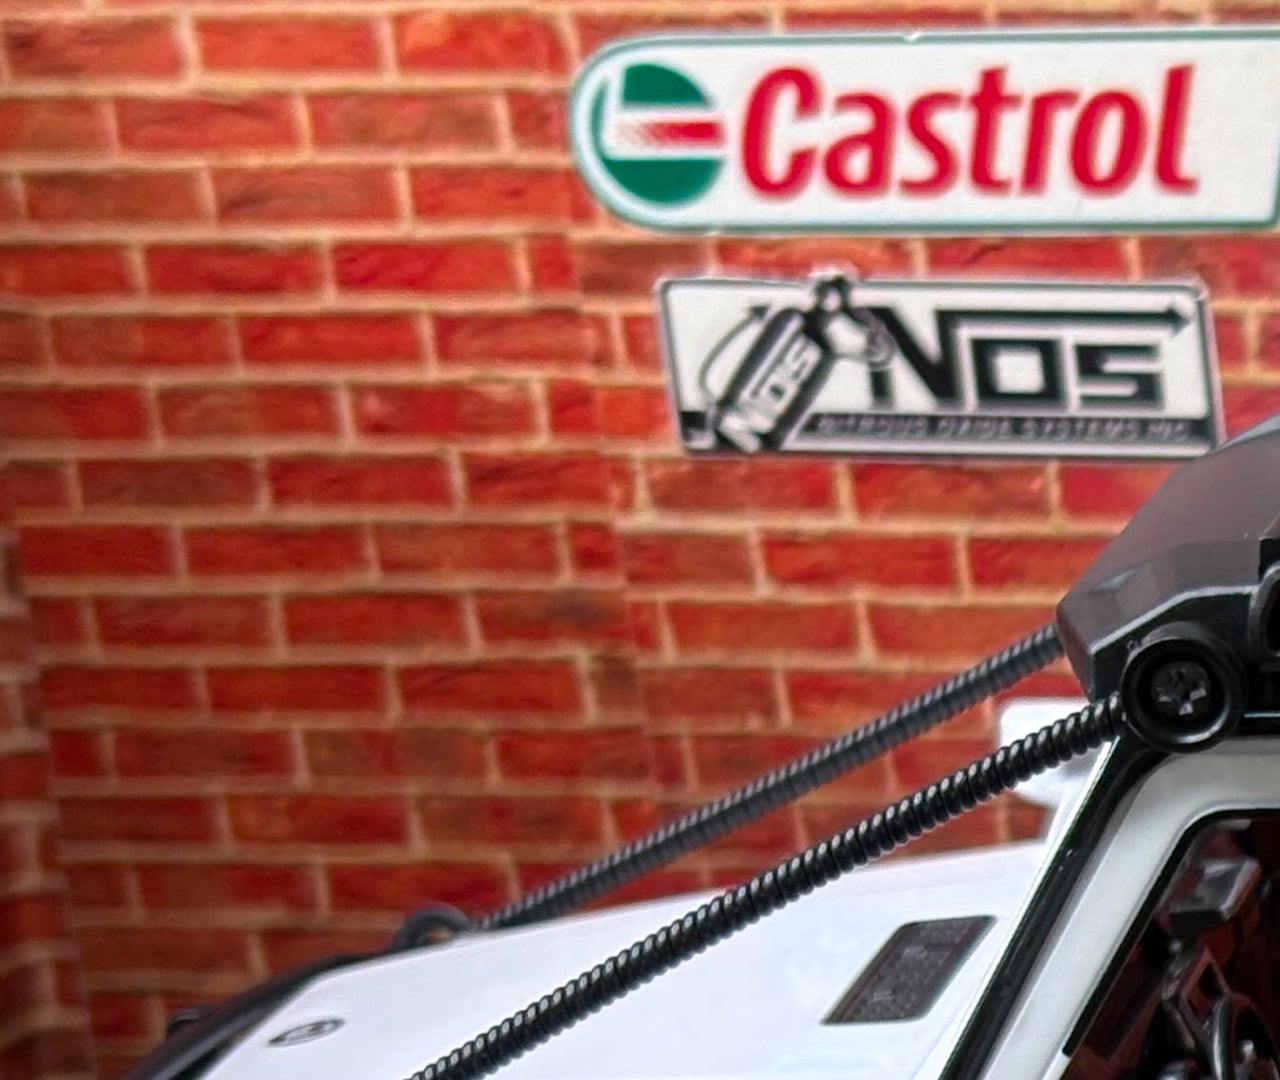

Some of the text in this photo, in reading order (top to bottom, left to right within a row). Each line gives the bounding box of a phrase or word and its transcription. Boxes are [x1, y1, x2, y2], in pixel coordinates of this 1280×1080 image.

[741, 63, 1198, 198] Castrol
[718, 333, 823, 453] NOS
[852, 306, 1170, 411] NOS
